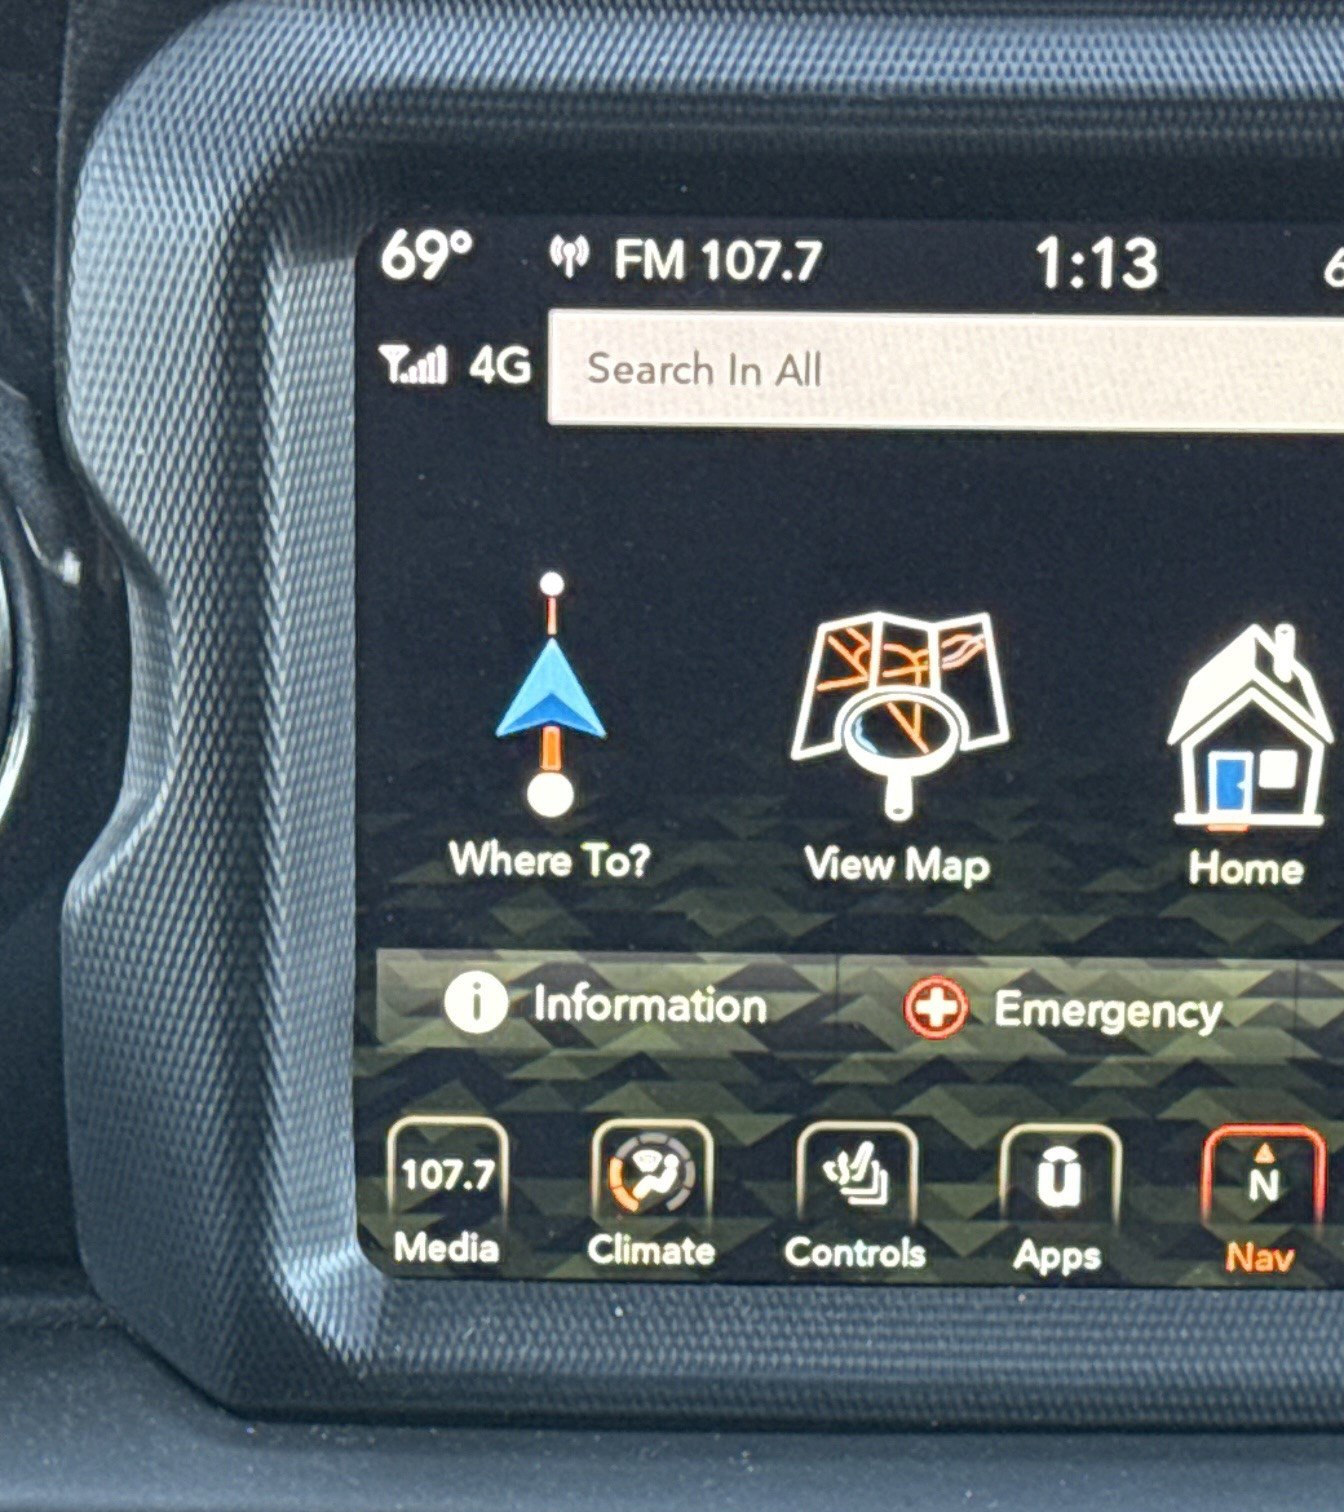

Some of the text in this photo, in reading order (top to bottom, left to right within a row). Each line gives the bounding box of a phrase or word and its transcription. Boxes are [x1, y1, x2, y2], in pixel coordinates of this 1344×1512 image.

[379, 227, 474, 282] 69°
[614, 237, 824, 283] FM 107.7
[1035, 234, 1159, 291] 1:13
[468, 343, 532, 386] 4G
[587, 348, 823, 388] Search In All
[447, 837, 653, 879] Where To?
[802, 843, 992, 891] View Map
[1188, 847, 1306, 887] Home
[534, 979, 769, 1025] Information
[994, 988, 1225, 1039] Emergency
[400, 1157, 497, 1192] 107.7
[1247, 1167, 1280, 1203] N
[393, 1229, 501, 1264] Media
[586, 1230, 717, 1267] Climate
[783, 1234, 928, 1270] Controls
[1011, 1237, 1103, 1278] Apps
[1224, 1240, 1296, 1274] Nav
